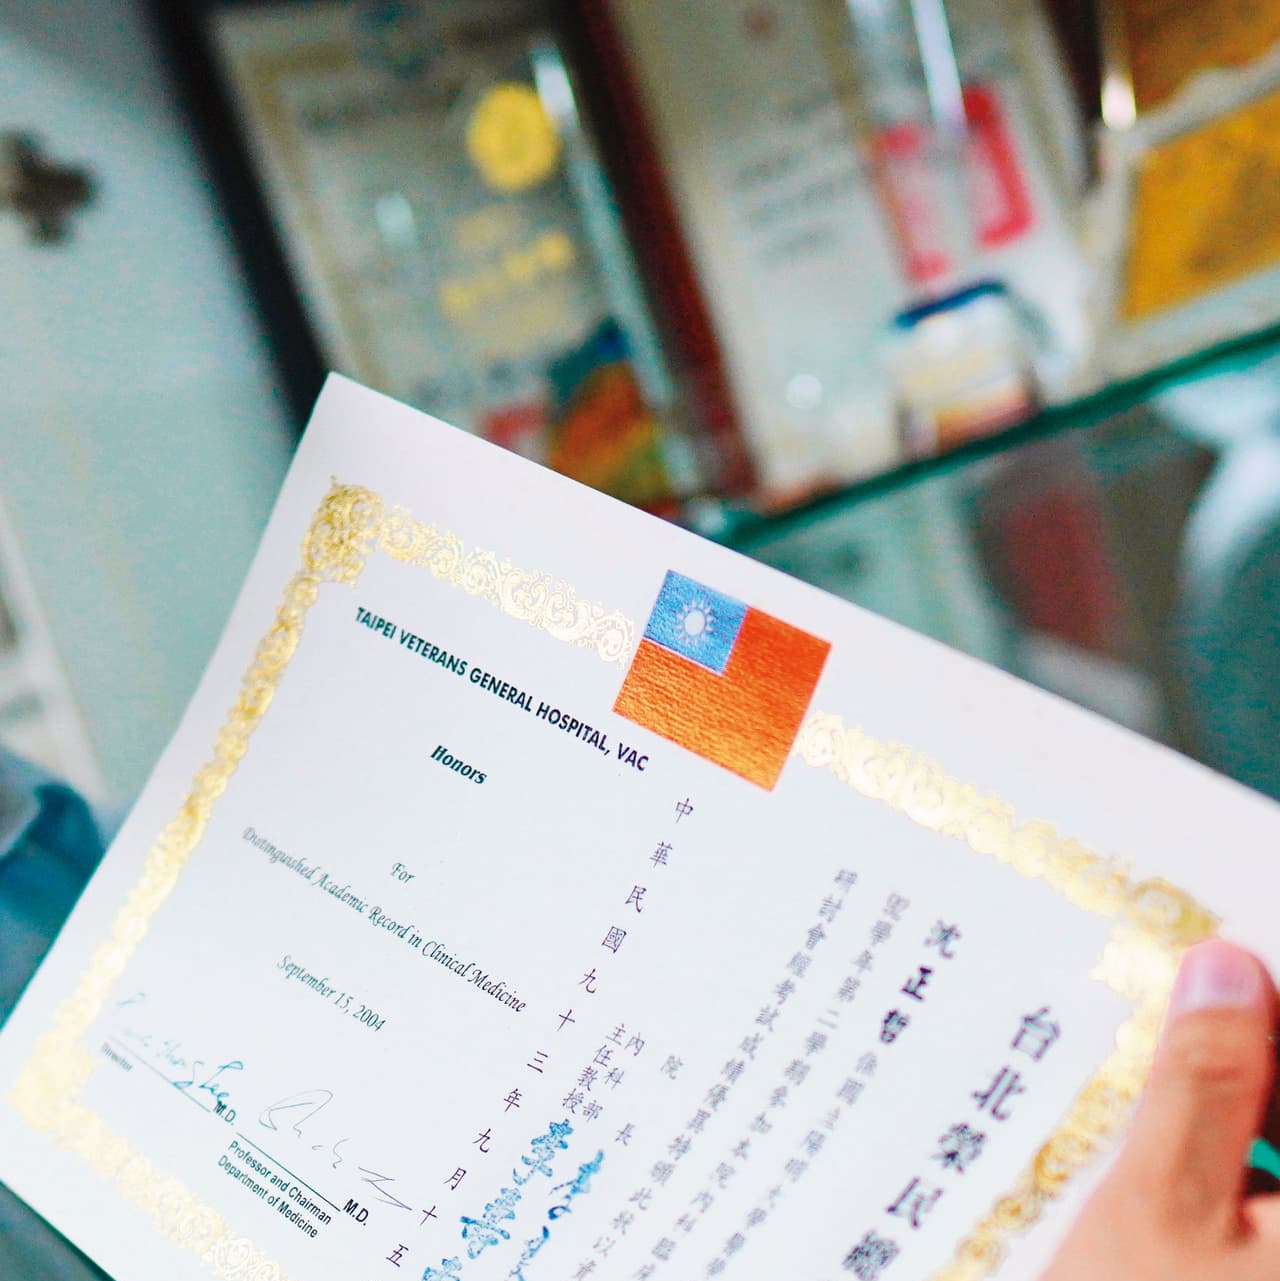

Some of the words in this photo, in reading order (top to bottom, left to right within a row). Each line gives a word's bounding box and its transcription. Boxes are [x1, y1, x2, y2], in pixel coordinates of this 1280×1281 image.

[355, 607, 397, 639] TAIPEI
[399, 628, 468, 677] VETERANS
[469, 667, 533, 712] GENERAL
[535, 701, 611, 755] HOSPITAL,
[616, 742, 650, 772] VAC
[430, 744, 488, 784] Honors
[390, 861, 416, 885] For
[242, 826, 320, 880] Distinguished
[312, 871, 368, 913] Academic
[368, 905, 414, 940] Record
[408, 929, 422, 949] in
[421, 940, 476, 978] Clinical
[467, 968, 528, 1014] Medicine
[276, 954, 337, 1000] September
[334, 992, 353, 1016] 15,
[352, 1004, 387, 1032] 2004
[560, 1023, 626, 1115] 主任教授
[213, 1100, 237, 1126] M.D.
[217, 1154, 269, 1202] Department
[266, 1191, 280, 1208] of
[276, 1199, 319, 1239] Medicine
[228, 1140, 272, 1181] Professor
[269, 1171, 290, 1193] and
[287, 1182, 333, 1226] Chairman
[342, 1198, 370, 1227] M.D.
